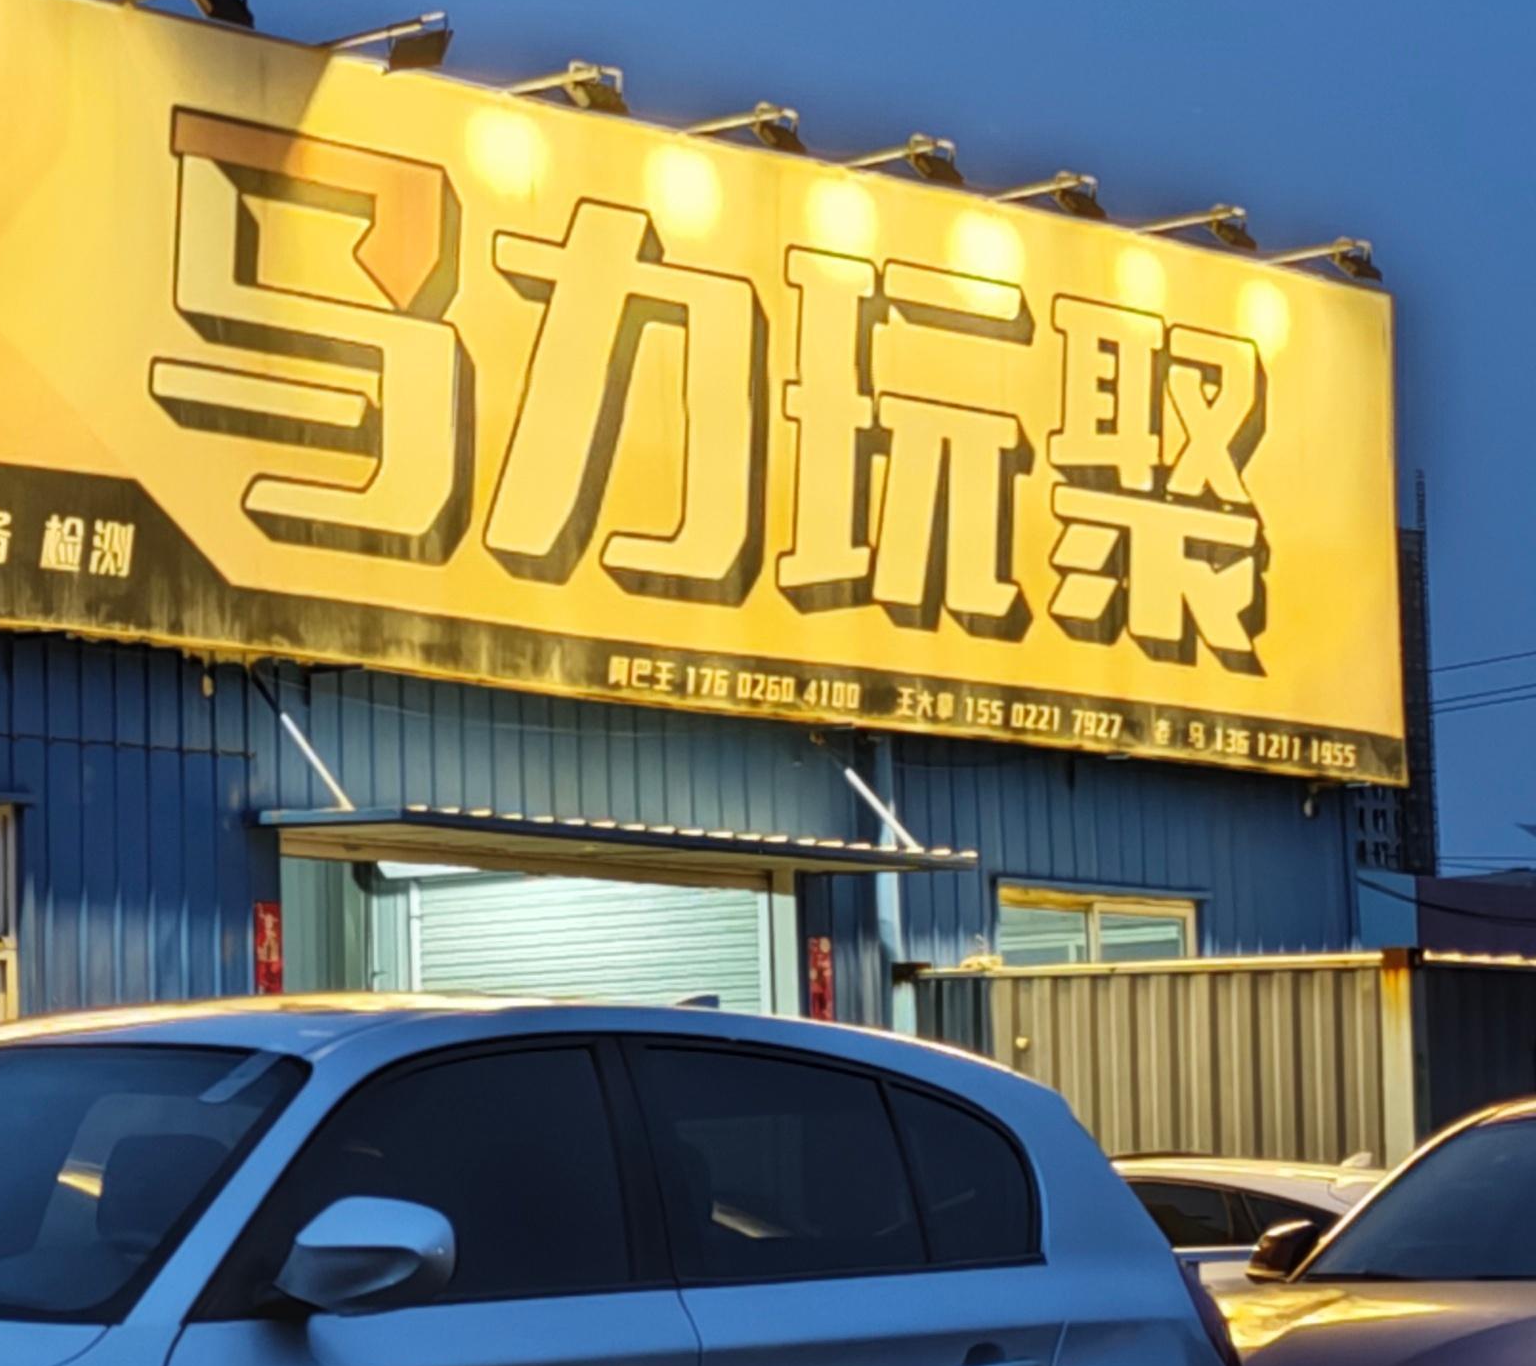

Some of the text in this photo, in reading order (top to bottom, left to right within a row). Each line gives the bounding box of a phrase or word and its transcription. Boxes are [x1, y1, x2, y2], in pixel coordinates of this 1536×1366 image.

[149, 104, 1269, 677] 马力玩聚
[39, 513, 135, 577] 检测
[685, 666, 731, 697] 176
[736, 671, 796, 703] 0260
[802, 678, 861, 709] 4100
[965, 697, 1005, 726] 155
[1010, 702, 1061, 733] 0221
[1071, 709, 1123, 739] 7927
[1215, 727, 1250, 755] 136
[1257, 732, 1301, 761] 1211
[1311, 739, 1357, 768] 1955
